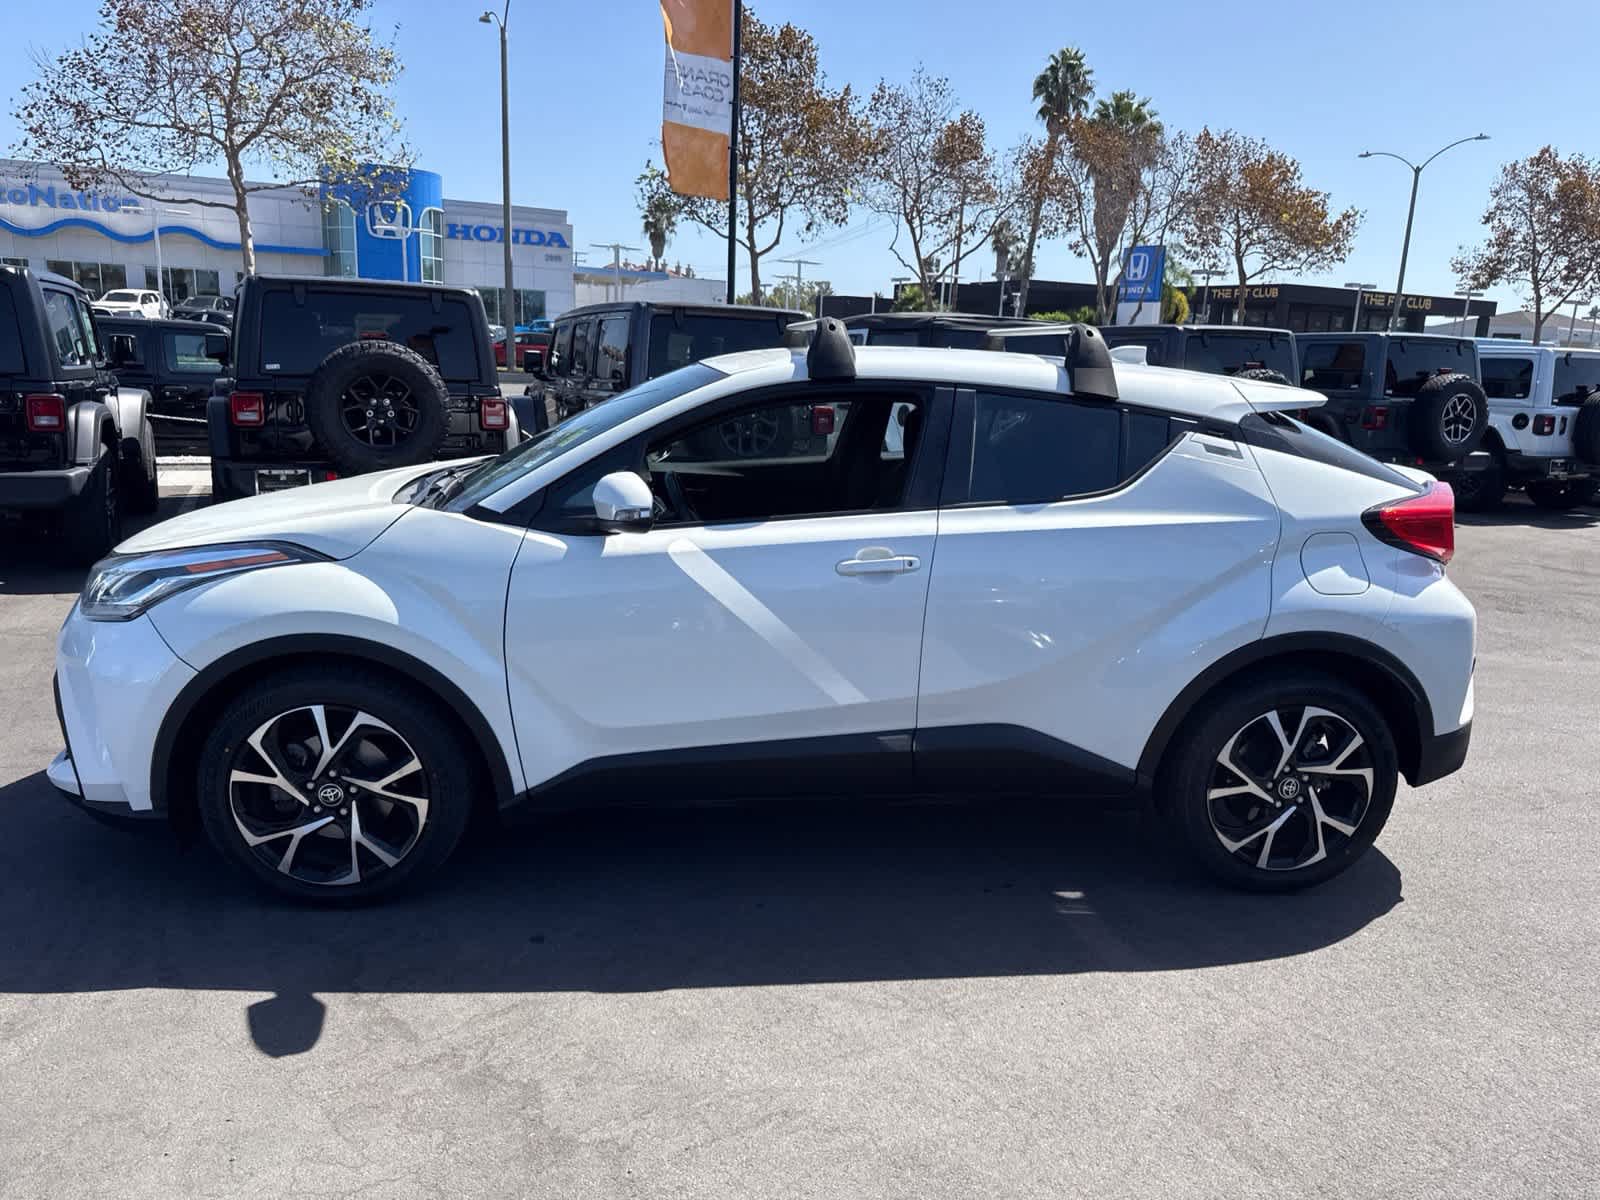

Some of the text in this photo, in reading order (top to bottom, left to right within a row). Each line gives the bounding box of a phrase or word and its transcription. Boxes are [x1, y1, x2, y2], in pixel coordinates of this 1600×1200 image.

[446, 223, 569, 248] HONDA
[1211, 287, 1279, 299] THE FT CLUB
[1363, 293, 1432, 310] THE FT CLUB
